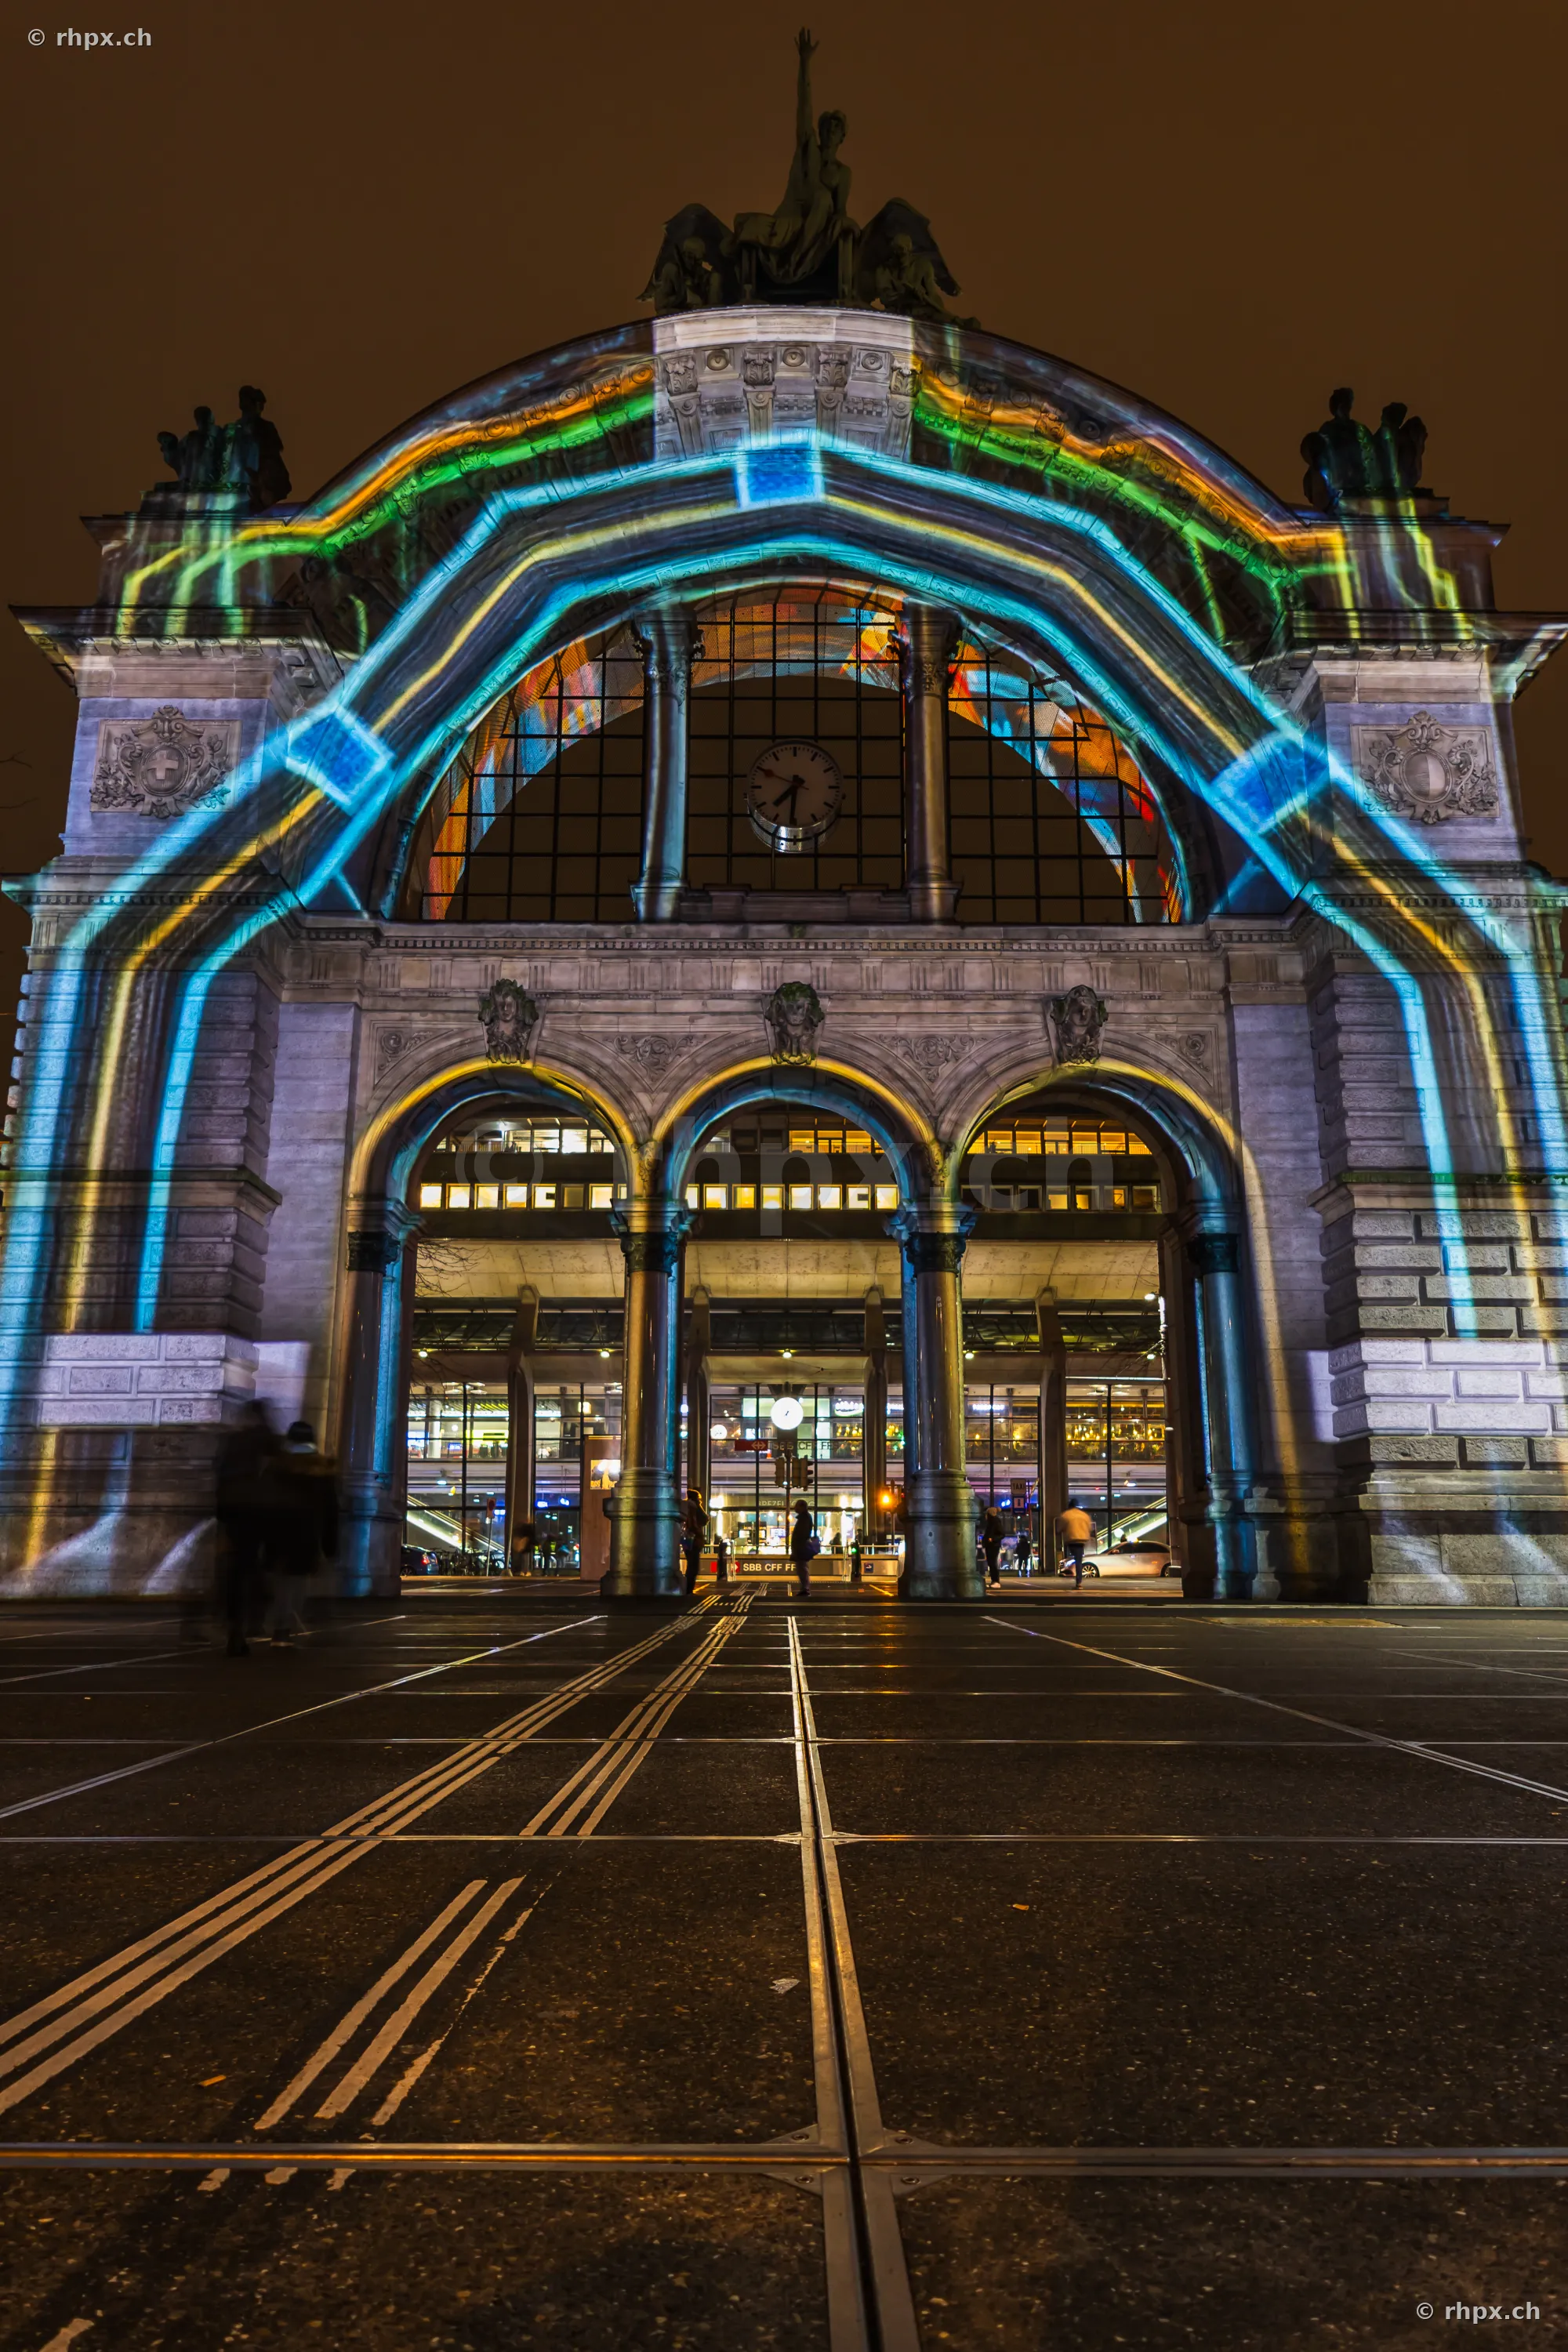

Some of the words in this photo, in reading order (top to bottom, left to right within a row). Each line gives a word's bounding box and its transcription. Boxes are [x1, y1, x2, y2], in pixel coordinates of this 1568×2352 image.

[742, 1563, 762, 1572] SBB
[764, 1563, 782, 1572] CFF
[785, 1563, 797, 1572] FF
